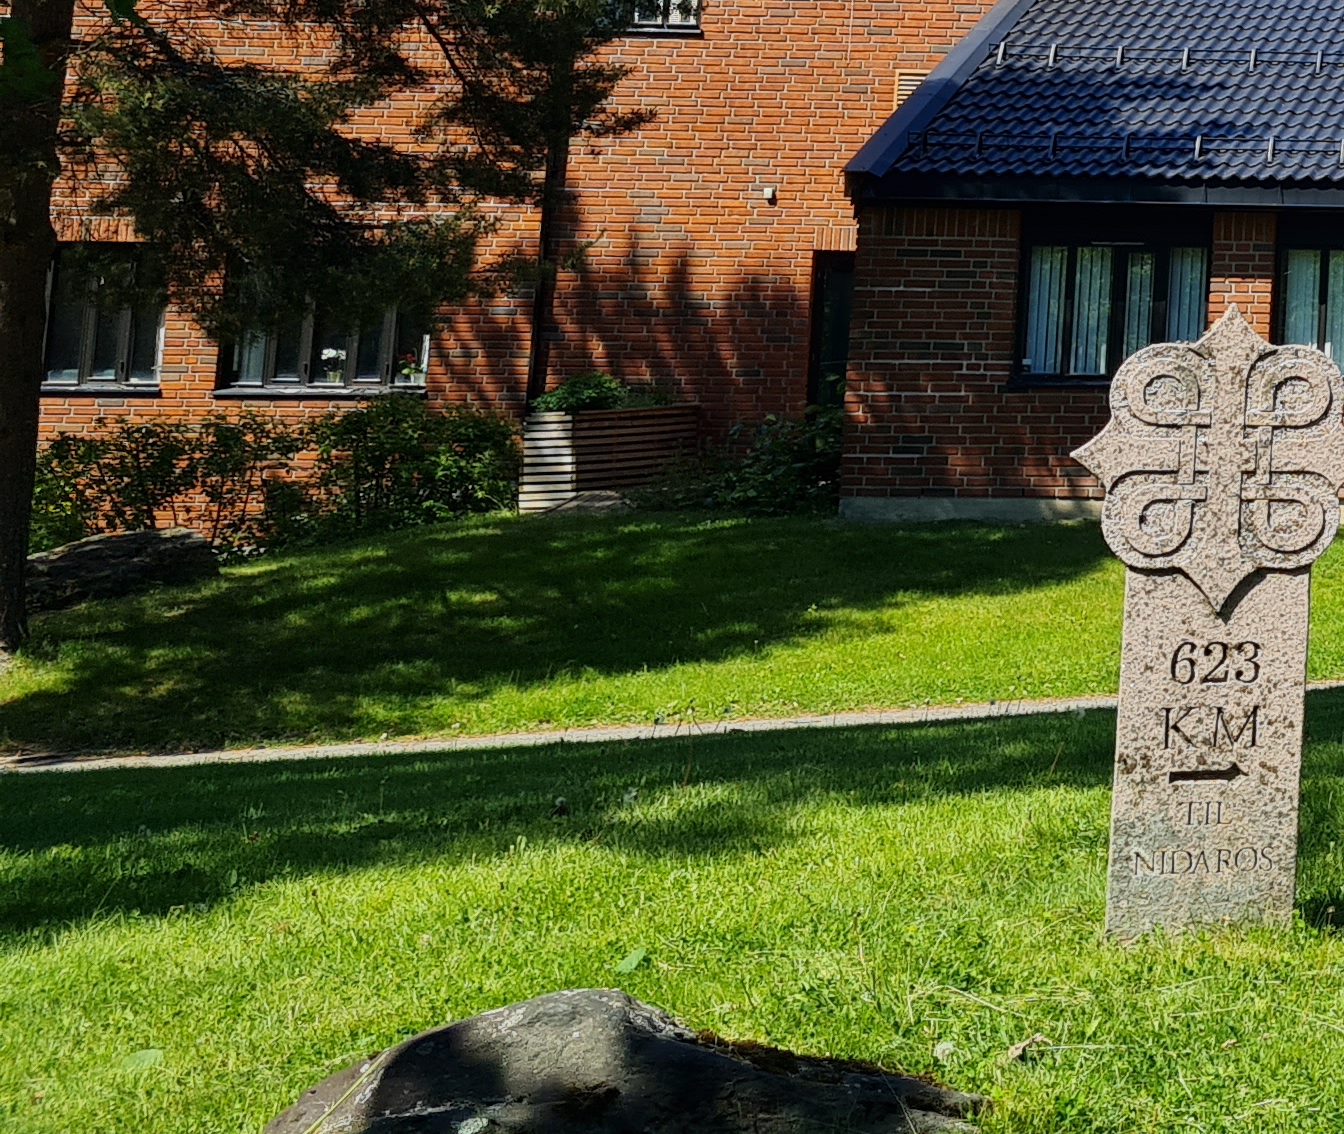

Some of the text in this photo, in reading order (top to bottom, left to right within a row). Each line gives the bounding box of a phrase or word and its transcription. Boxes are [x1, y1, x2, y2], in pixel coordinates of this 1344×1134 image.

[1170, 640, 1262, 685] 623
[1161, 705, 1262, 750] KM
[1177, 801, 1233, 826] TIL
[1133, 846, 1275, 876] NIDAROS
